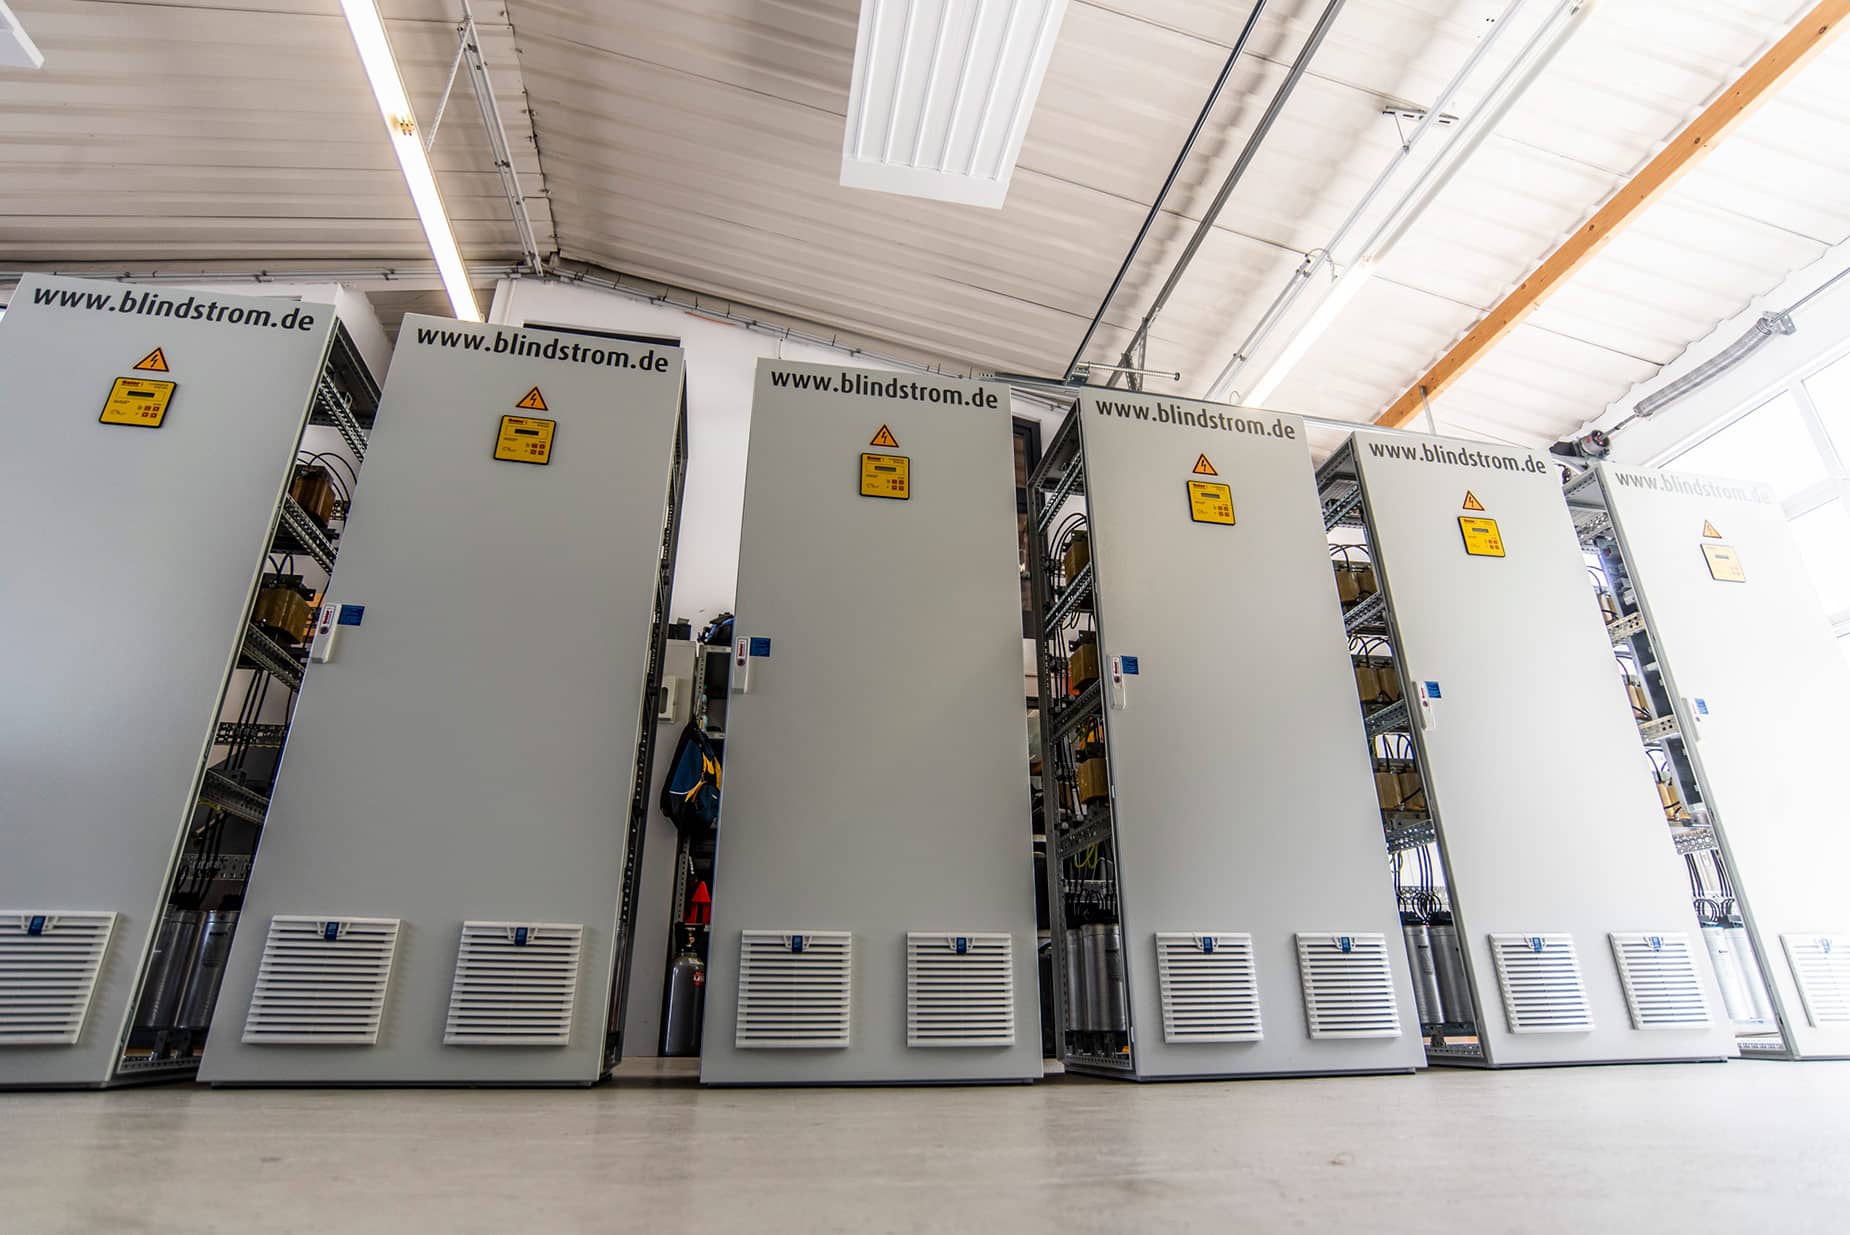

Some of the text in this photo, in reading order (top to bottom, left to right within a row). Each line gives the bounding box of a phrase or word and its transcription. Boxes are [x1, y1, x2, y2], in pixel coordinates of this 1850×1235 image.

[33, 287, 314, 331] www.blindstrom.de
[417, 328, 668, 372] www.blindstrom.de
[771, 371, 998, 409] www.blindstrom.de
[1096, 400, 1295, 439] www.blindstrom.de
[1369, 443, 1547, 474] www.blindstrom.de
